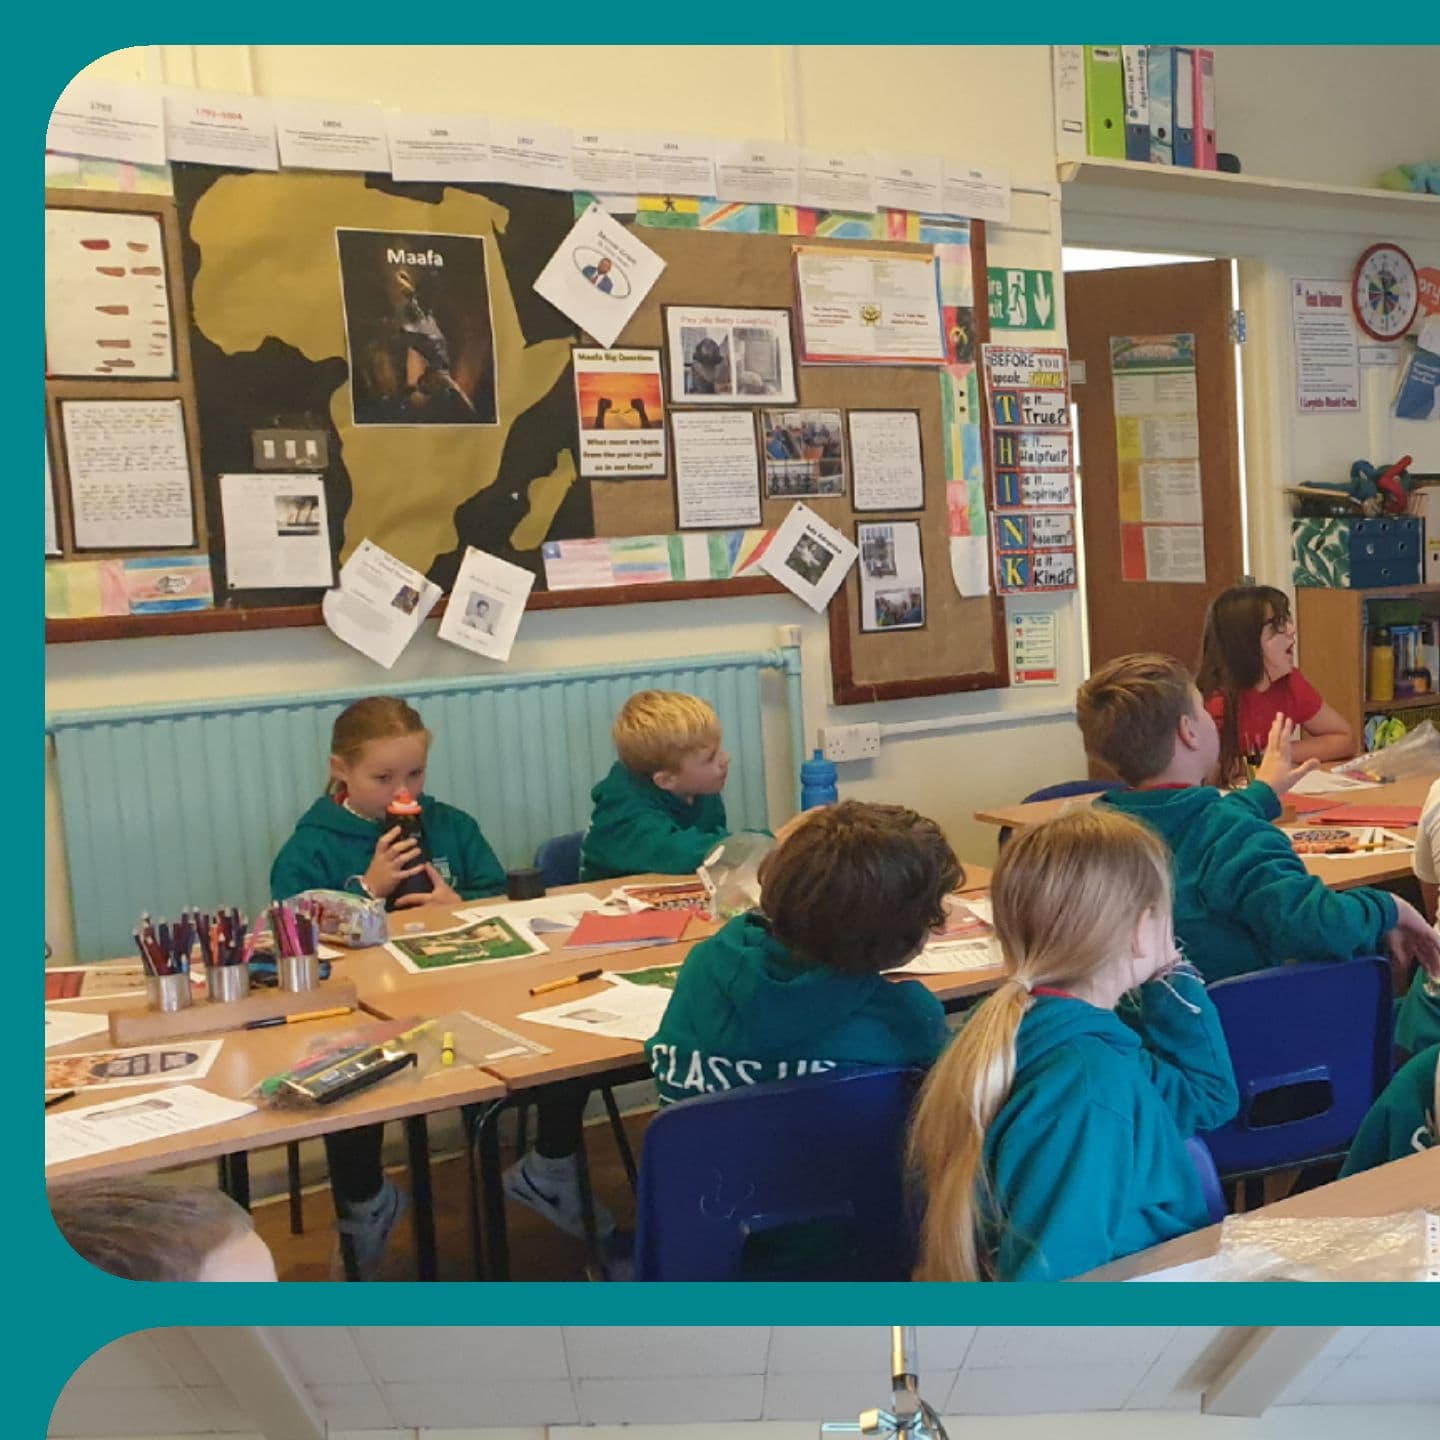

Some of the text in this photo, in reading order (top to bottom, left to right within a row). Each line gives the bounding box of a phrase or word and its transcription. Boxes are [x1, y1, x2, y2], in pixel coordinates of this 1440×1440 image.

[387, 248, 443, 266] Maafa
[987, 276, 1003, 297] ire
[991, 353, 1034, 367] BEFORE
[996, 395, 1017, 424] T
[1024, 408, 1064, 424] True?
[1000, 437, 1013, 465] H
[1021, 449, 1067, 465] Helpful?
[1003, 518, 1023, 546] N
[1005, 558, 1025, 587] K
[1033, 568, 1073, 586] Kind?
